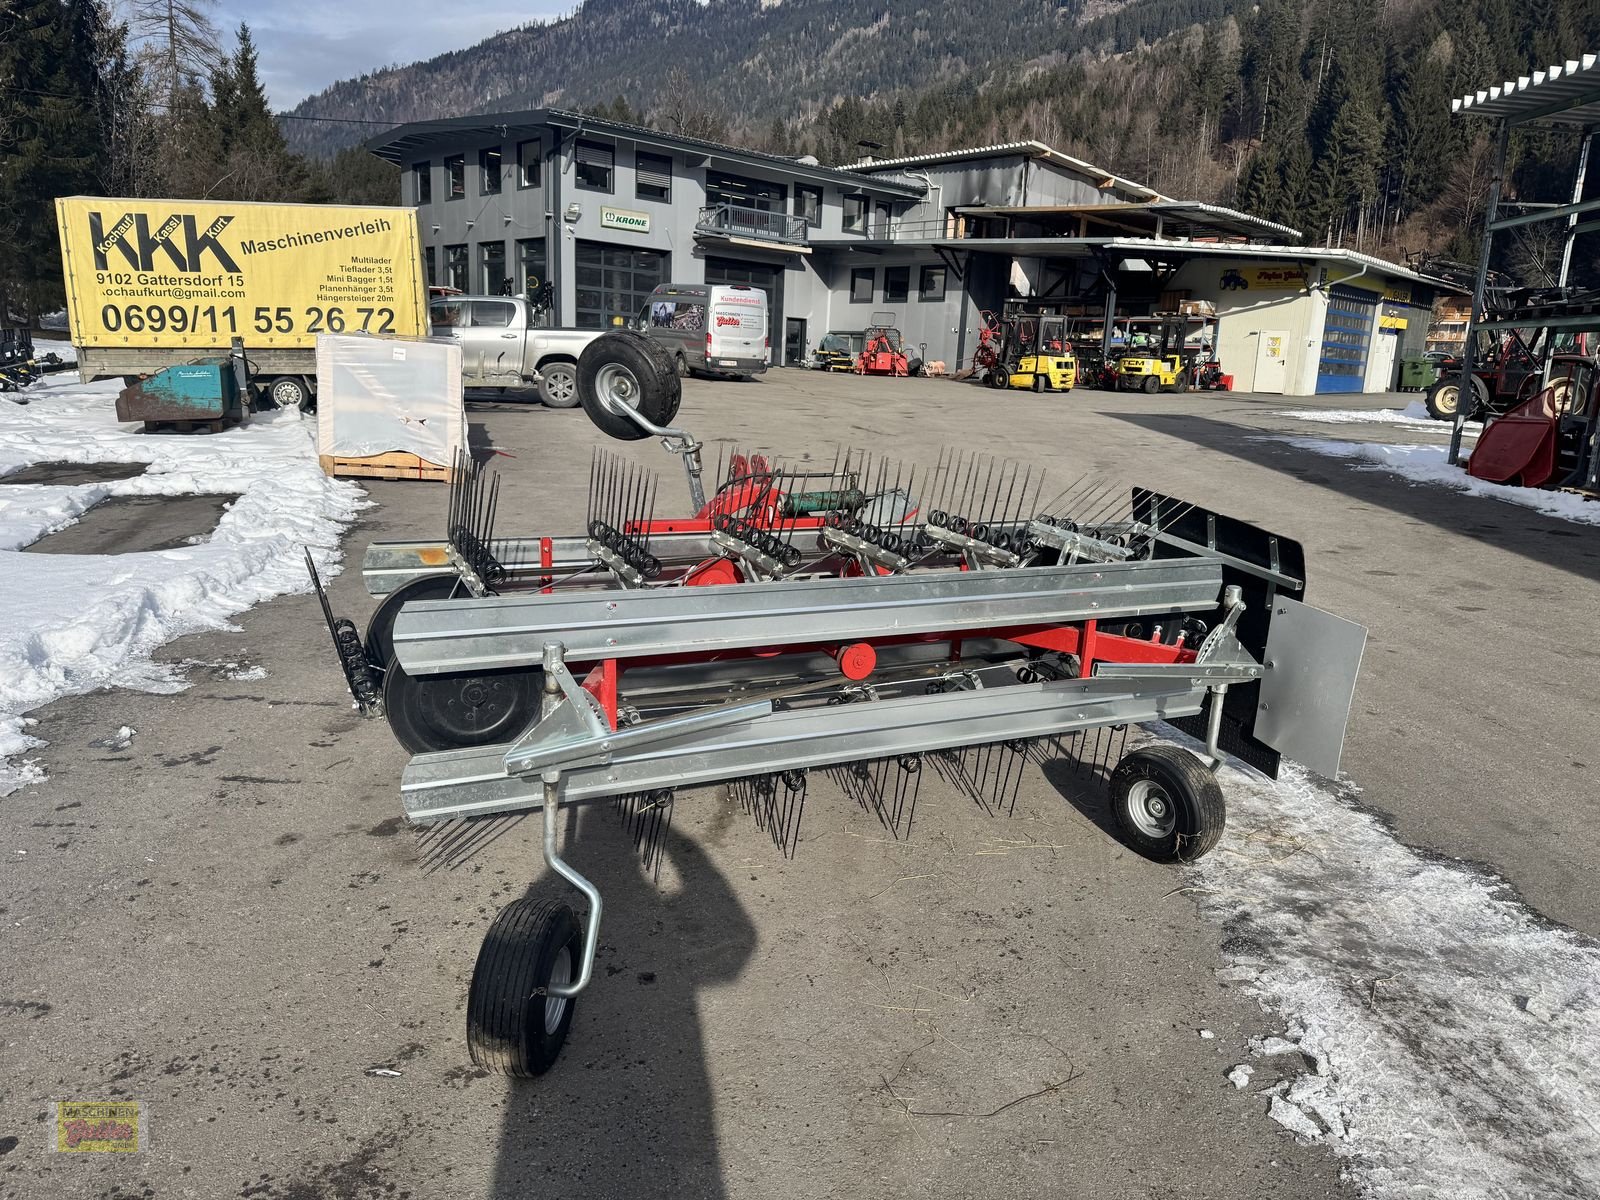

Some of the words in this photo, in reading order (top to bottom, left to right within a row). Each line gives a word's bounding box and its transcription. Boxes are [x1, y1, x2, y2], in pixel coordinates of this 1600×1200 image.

[615, 216, 648, 227] KRONE
[153, 216, 181, 244] Kassl
[205, 217, 228, 239] Kurt
[96, 214, 135, 255] Kochauf
[240, 218, 391, 255] Maschinenverleih
[88, 211, 242, 273] KKK
[351, 256, 392, 265] Multilader
[339, 265, 375, 274] Tieflader
[377, 266, 393, 275] 3,5t
[96, 273, 132, 285] 9102
[137, 274, 223, 287] Gattersdorf
[228, 275, 244, 287] 15
[326, 275, 344, 283] Mini
[347, 275, 376, 285] Bagger
[378, 276, 393, 284] 1,5t
[319, 284, 376, 294] Planenhänger
[378, 286, 394, 294] 3,5t
[316, 294, 375, 303] Hängersteiger
[376, 294, 394, 302] 20m
[720, 295, 761, 305] Kundendienst
[101, 304, 237, 333] 0699/11
[254, 306, 294, 334] 55
[305, 306, 346, 333] 26
[356, 307, 396, 334] 72
